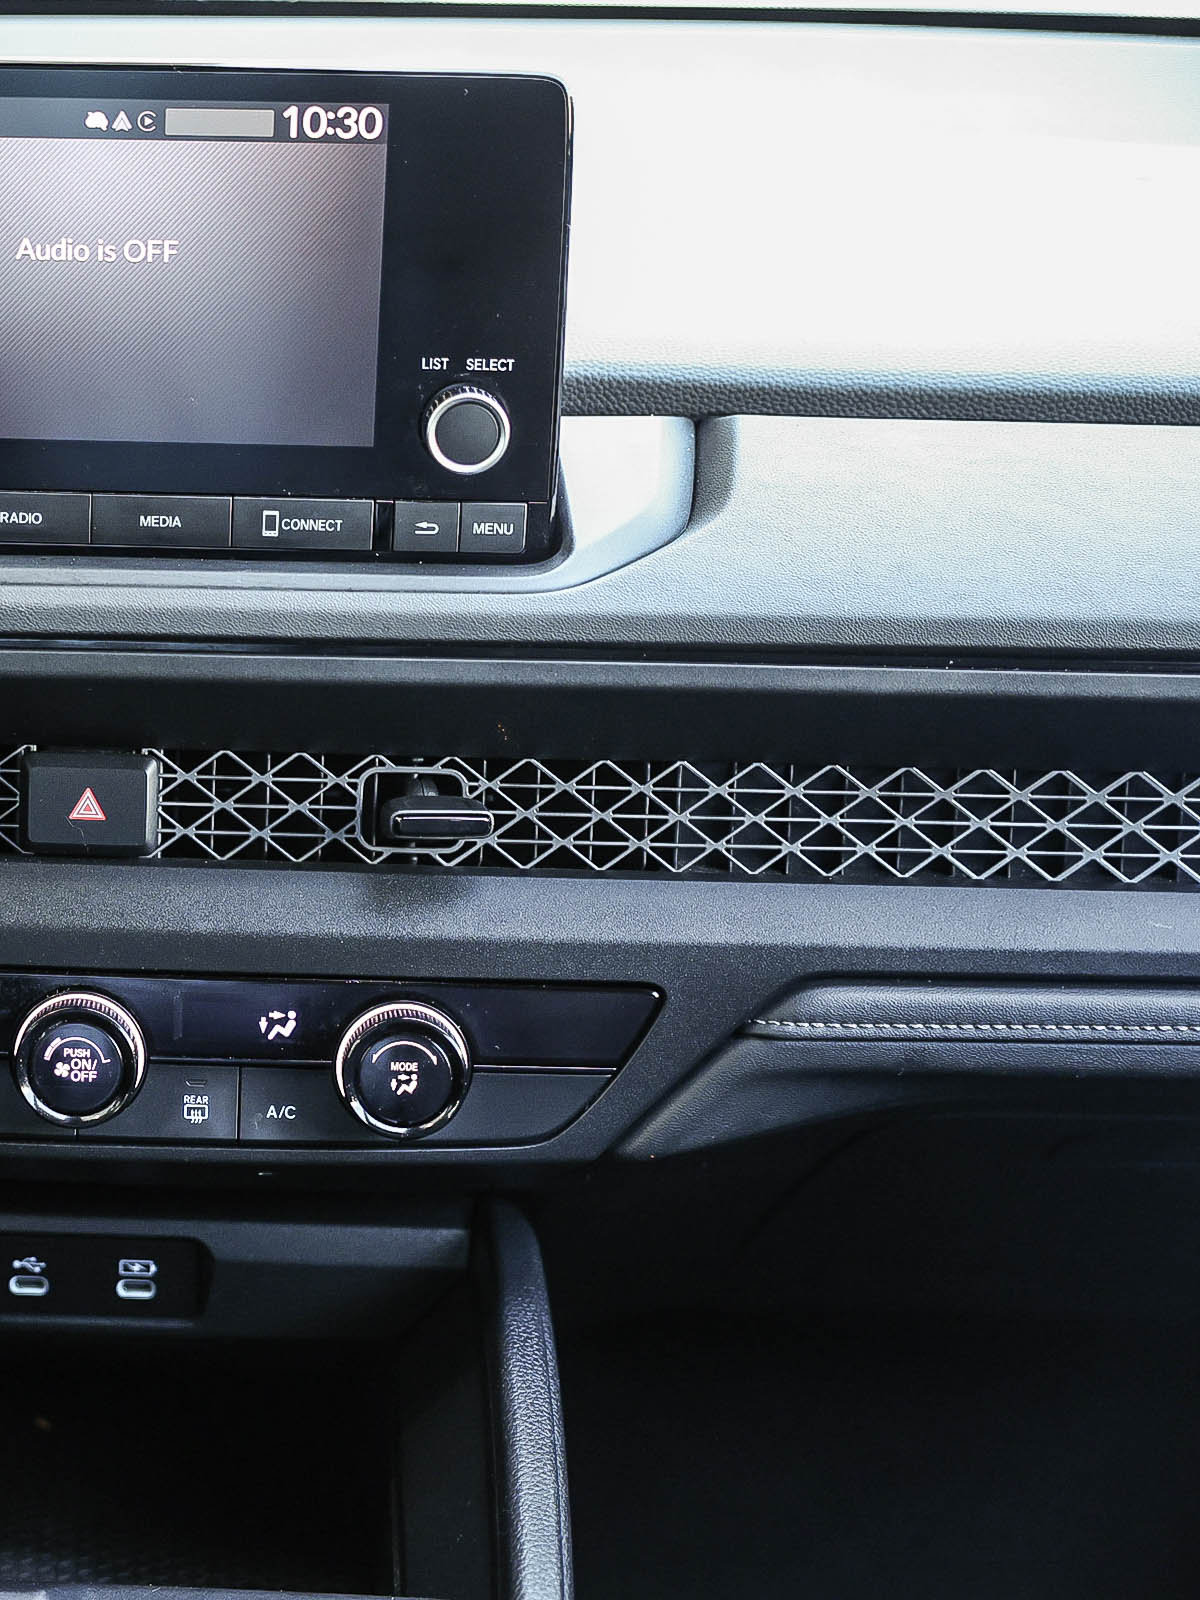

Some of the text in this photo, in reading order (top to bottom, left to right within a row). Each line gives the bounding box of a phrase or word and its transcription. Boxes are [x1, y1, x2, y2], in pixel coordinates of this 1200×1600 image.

[282, 105, 383, 140] 10:30
[15, 237, 180, 263] Audio is OFF
[421, 357, 450, 371] LIST
[464, 357, 516, 372] SELECT
[0, 511, 43, 525] RADIO
[139, 515, 183, 528] MEDIA
[281, 518, 344, 533] CONNECT
[472, 522, 515, 537] MENU
[62, 1046, 91, 1059] PUSH
[70, 1058, 98, 1071] ON/
[390, 1061, 419, 1072] MODE
[69, 1068, 98, 1083] OFF
[183, 1094, 209, 1105] REAR
[265, 1104, 297, 1120] A/C
